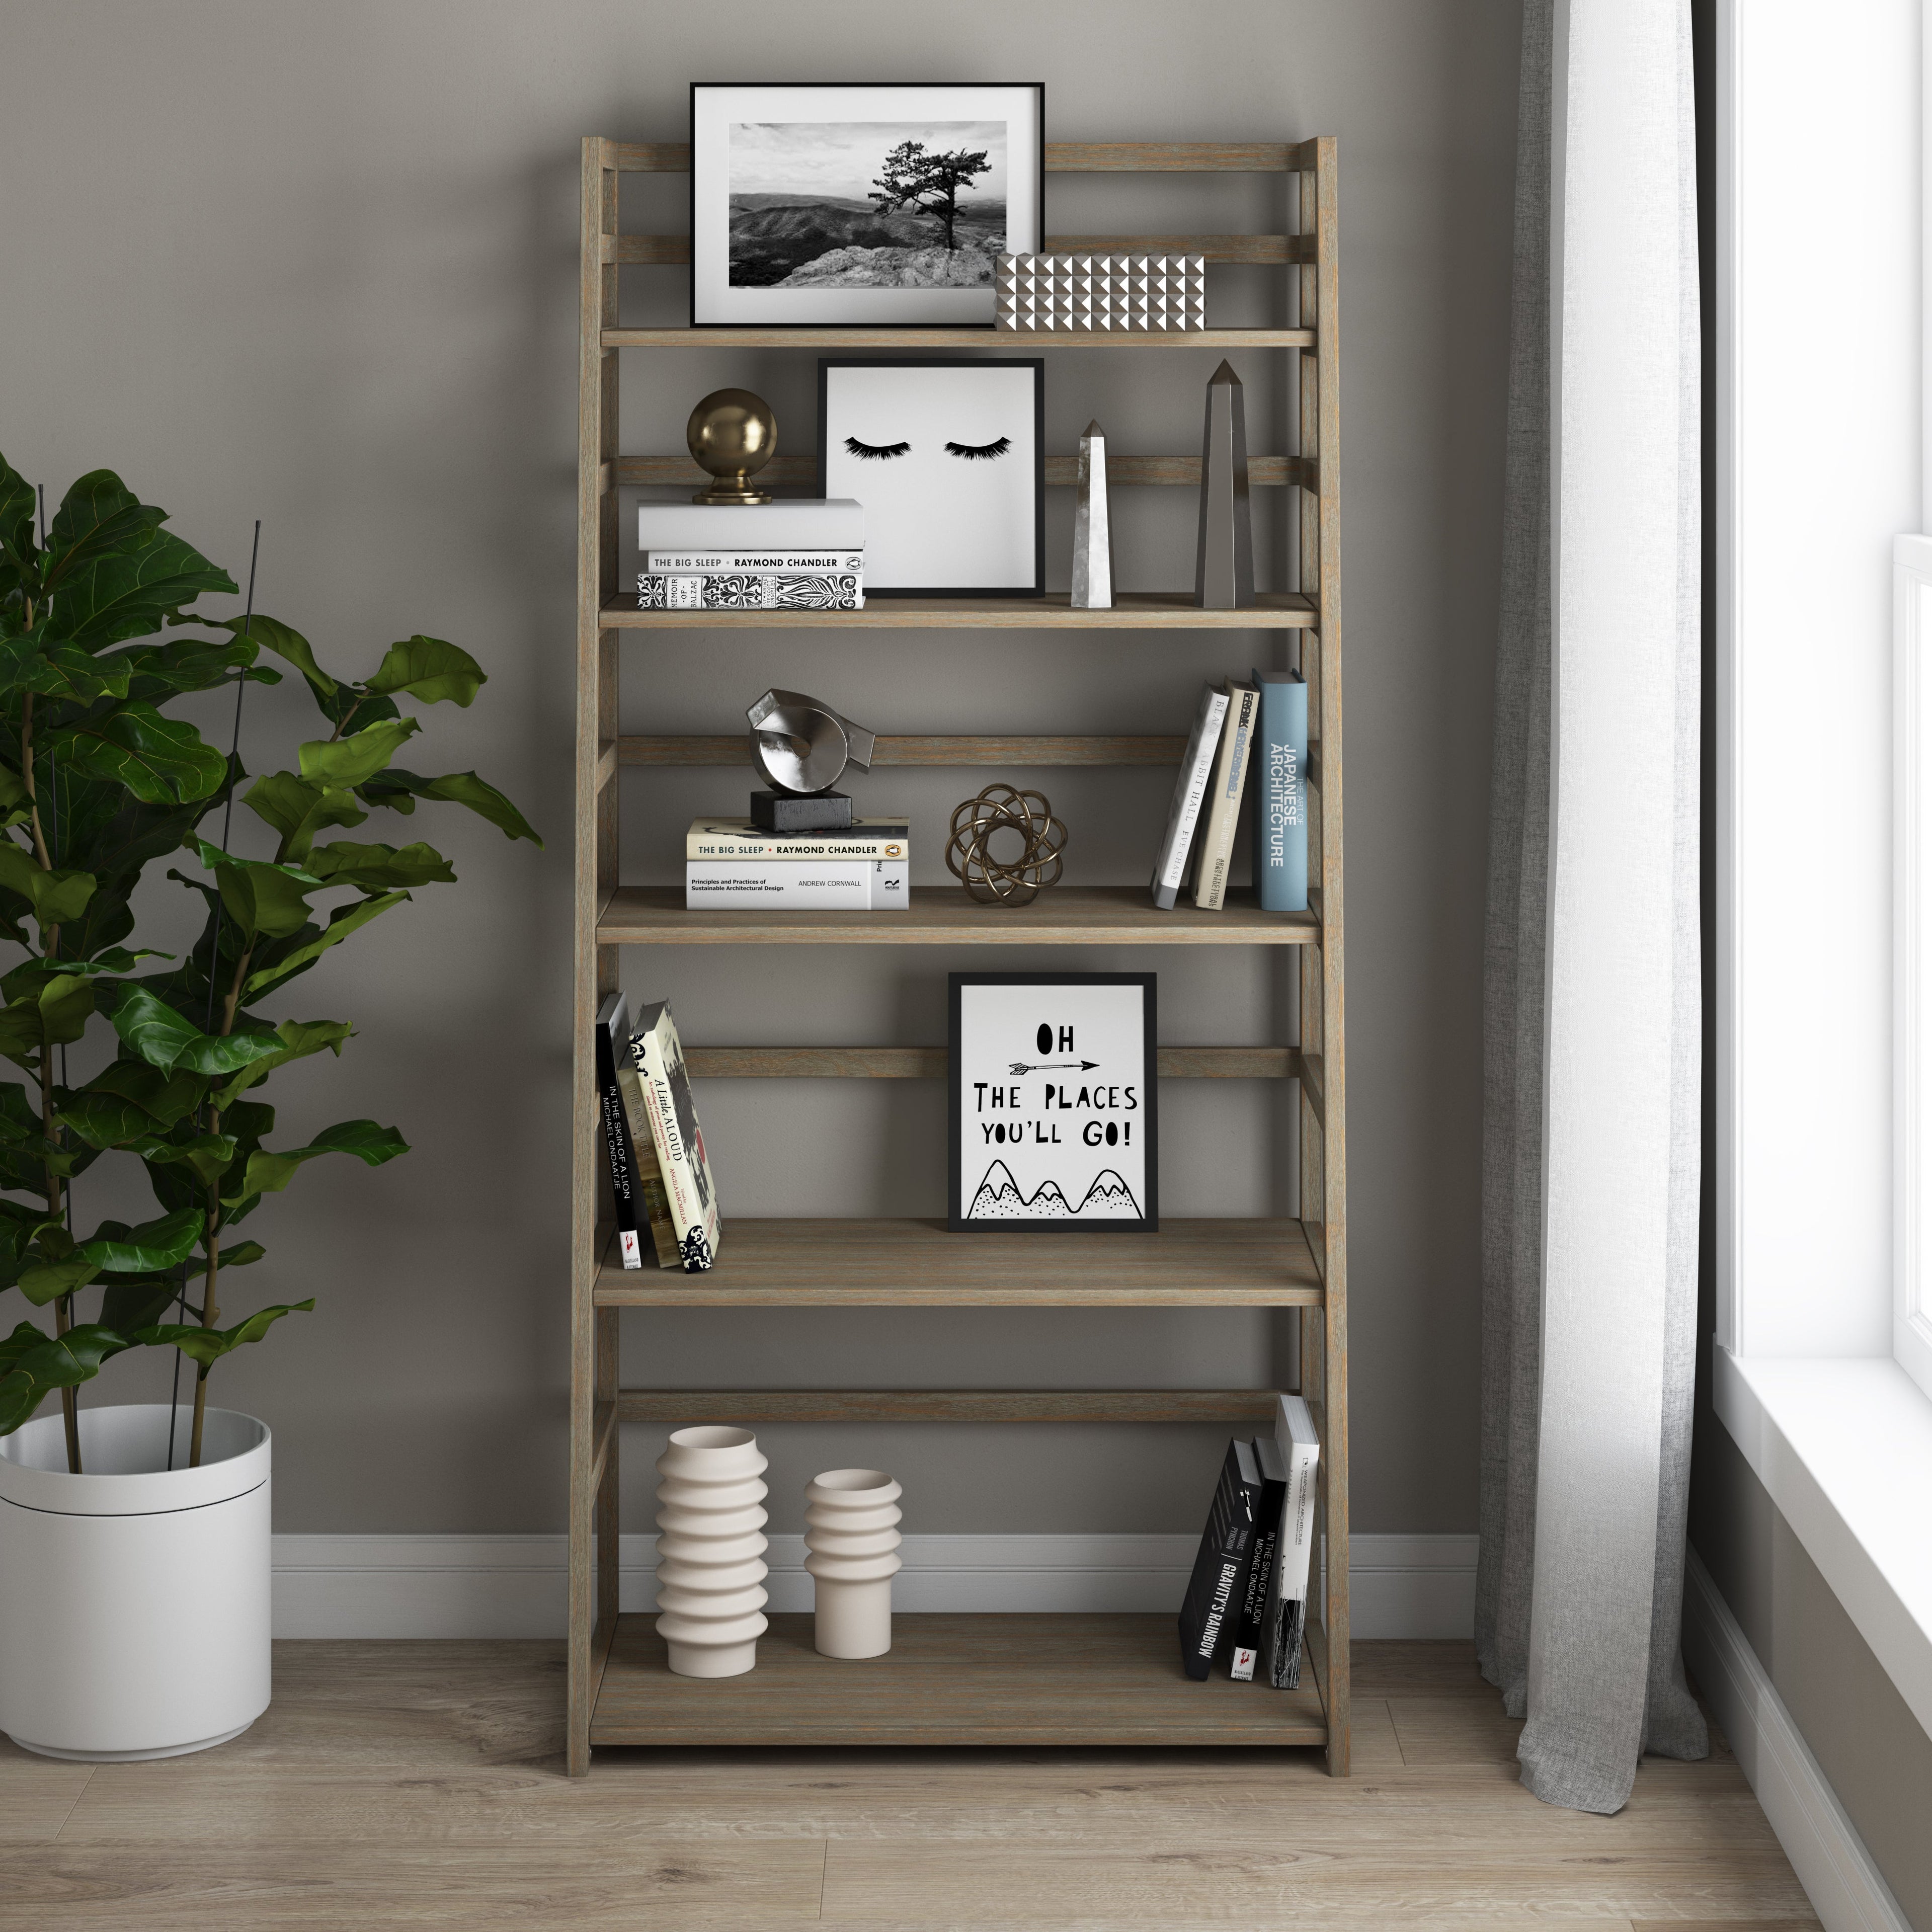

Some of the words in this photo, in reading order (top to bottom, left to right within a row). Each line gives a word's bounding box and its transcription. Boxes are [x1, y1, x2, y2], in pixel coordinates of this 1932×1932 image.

[1209, 700, 1225, 738] BLACK
[1238, 692, 1254, 729] FRANK
[1283, 744, 1297, 826] JAPANESE
[1185, 791, 1200, 821] HALL
[1270, 743, 1283, 867] ARCHITECTURE
[1297, 814, 1304, 826] OF
[1179, 831, 1189, 848] EVE
[1170, 852, 1183, 881] CHASE
[1209, 858, 1221, 907] CONSTRUCTIONS
[1213, 859, 1225, 906] ARCHITECTURAL
[1036, 1023, 1074, 1055] OH
[609, 1086, 617, 1096] IN
[655, 1079, 665, 1087] A
[612, 1098, 620, 1119] THE
[629, 1087, 639, 1106] THE
[657, 1090, 671, 1116] Little,
[974, 1082, 1021, 1112] THE
[1045, 1083, 1138, 1110] PLACES
[633, 1107, 646, 1133] BOOK
[603, 1097, 613, 1138] MICHAEL
[608, 1140, 621, 1189] ONDAATJE
[614, 1122, 623, 1146] SKIN
[639, 1134, 652, 1157] TITLE
[664, 1117, 682, 1161] ALOUD
[981, 1120, 1062, 1145] YOU'LL
[1082, 1120, 1131, 1147] GO!
[618, 1148, 626, 1163] OF
[621, 1175, 630, 1199] LION
[650, 1180, 660, 1208] AUTHOR
[670, 1168, 679, 1190] ANGELA
[675, 1191, 687, 1225] MACMILLAN
[1226, 1526, 1239, 1550] PYNCHON
[1236, 1530, 1248, 1550] THOMAS
[1267, 1532, 1276, 1541] IN
[1251, 1539, 1264, 1572] MICHAEL
[1264, 1543, 1274, 1560] THE
[1260, 1561, 1270, 1581] SKIN
[1211, 1563, 1237, 1613] GRAVITY'S
[1244, 1573, 1257, 1614] ONDAATJE
[1258, 1583, 1266, 1595] OF
[1252, 1603, 1263, 1624] LION
[1198, 1612, 1223, 1658] RAINBOW
